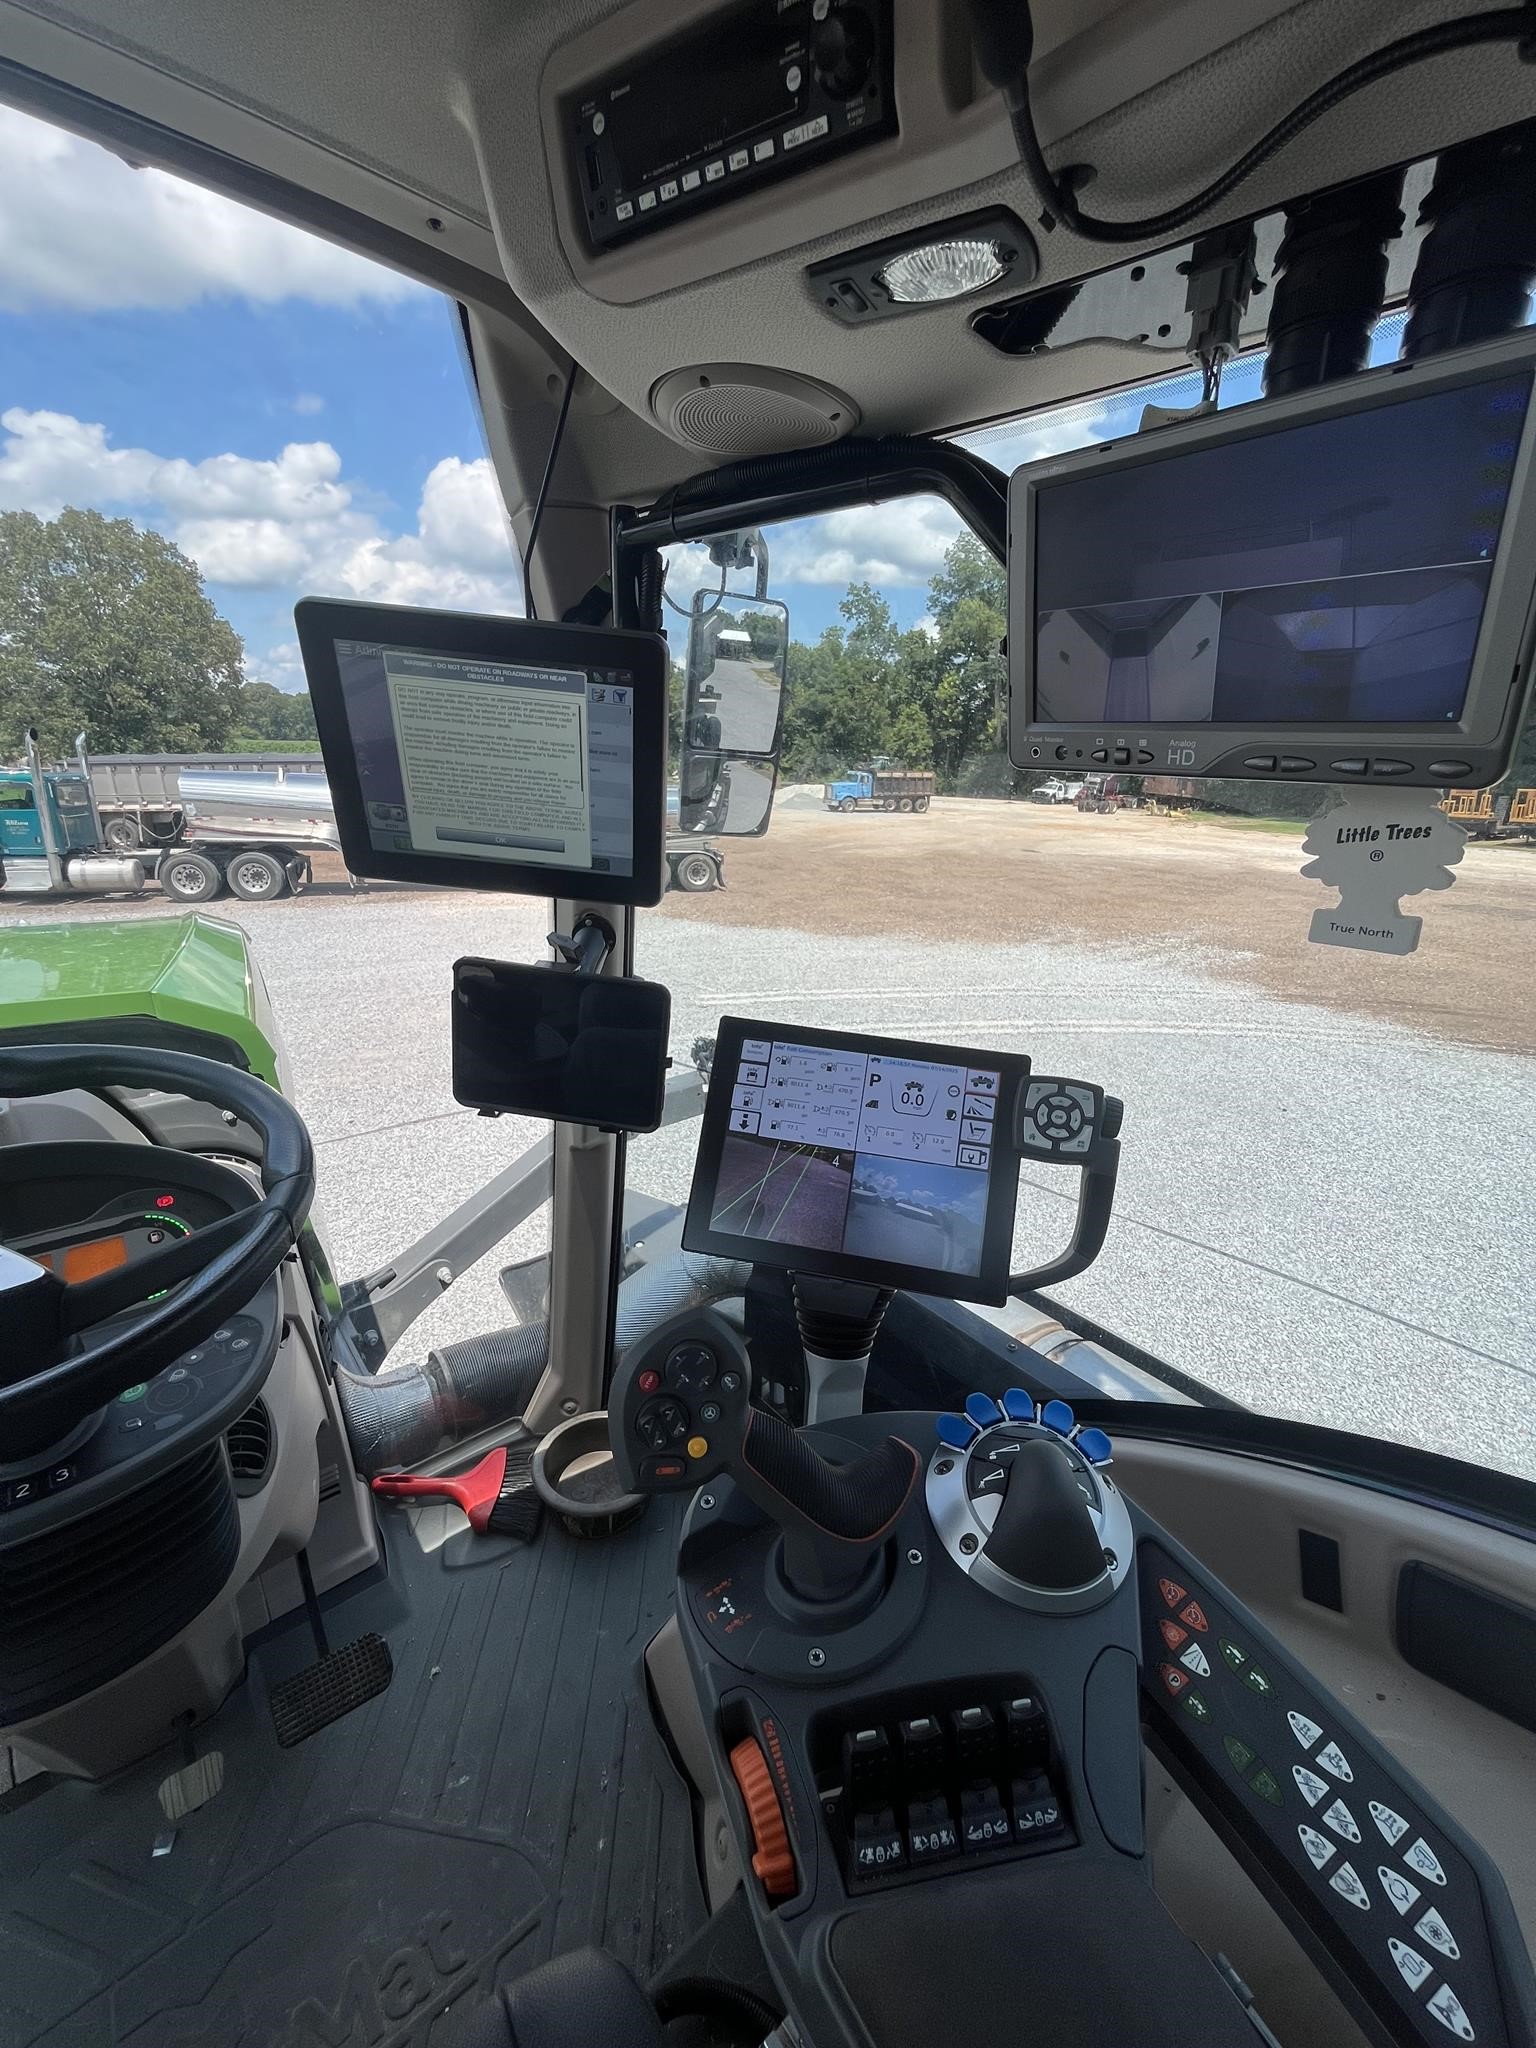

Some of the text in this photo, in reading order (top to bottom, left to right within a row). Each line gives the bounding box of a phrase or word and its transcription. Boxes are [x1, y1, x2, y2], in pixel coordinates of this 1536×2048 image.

[462, 665, 491, 674] OPERATE
[502, 669, 538, 680] ROADWAYS
[550, 674, 567, 682] NEAR
[467, 672, 504, 683] OBSTACLES
[1169, 739, 1196, 749] Analog
[1167, 749, 1195, 766] HD
[1336, 824, 1432, 844] Little Trees
[1329, 922, 1394, 939] True North
[869, 1073, 882, 1087] P
[901, 1092, 925, 1106] 0.0
[832, 1154, 840, 1168] 4
[55, 1468, 70, 1482] 3
[15, 1483, 31, 1498] 2
